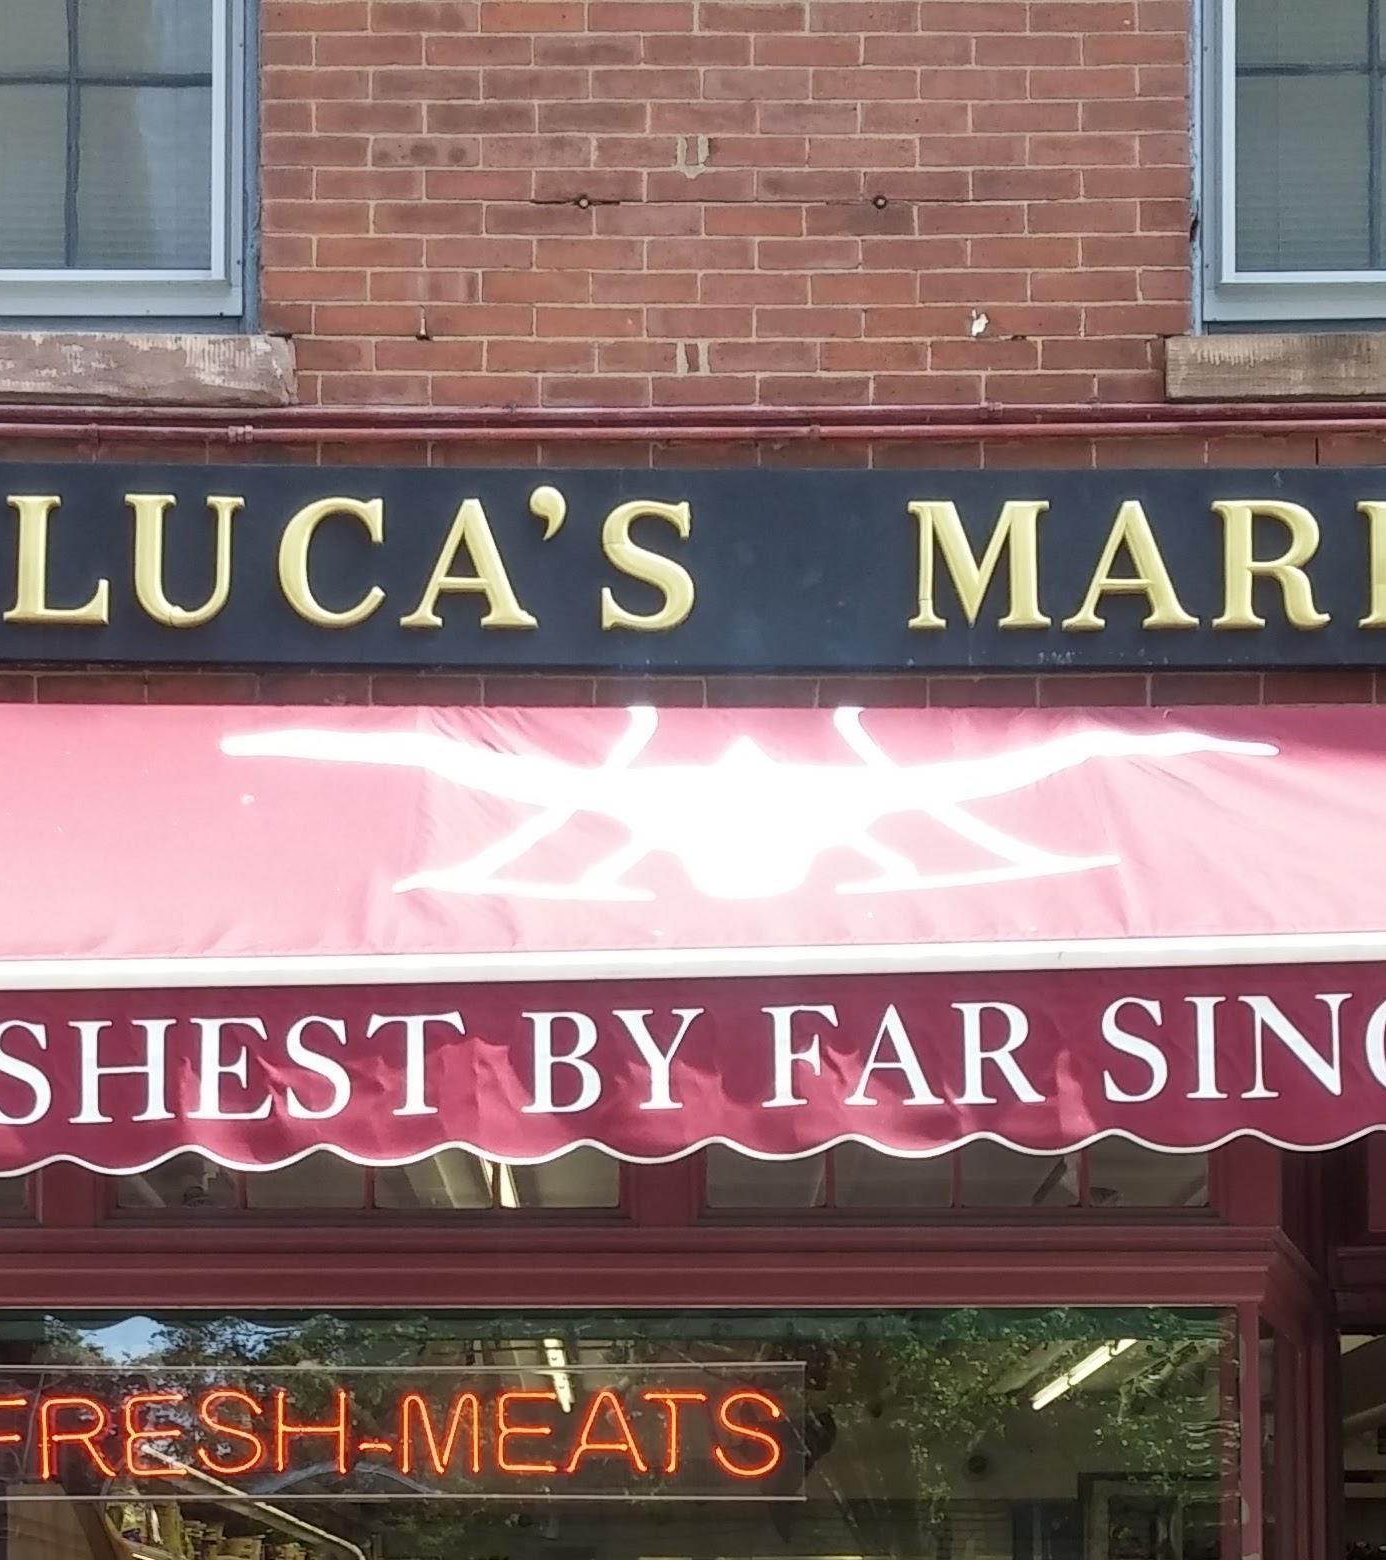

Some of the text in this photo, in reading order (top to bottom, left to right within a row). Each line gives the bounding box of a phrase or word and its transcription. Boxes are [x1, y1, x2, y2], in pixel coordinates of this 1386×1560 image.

[4, 486, 696, 629] LUCA'S
[520, 1006, 707, 1115] BY
[759, 1001, 1045, 1111] FAR
